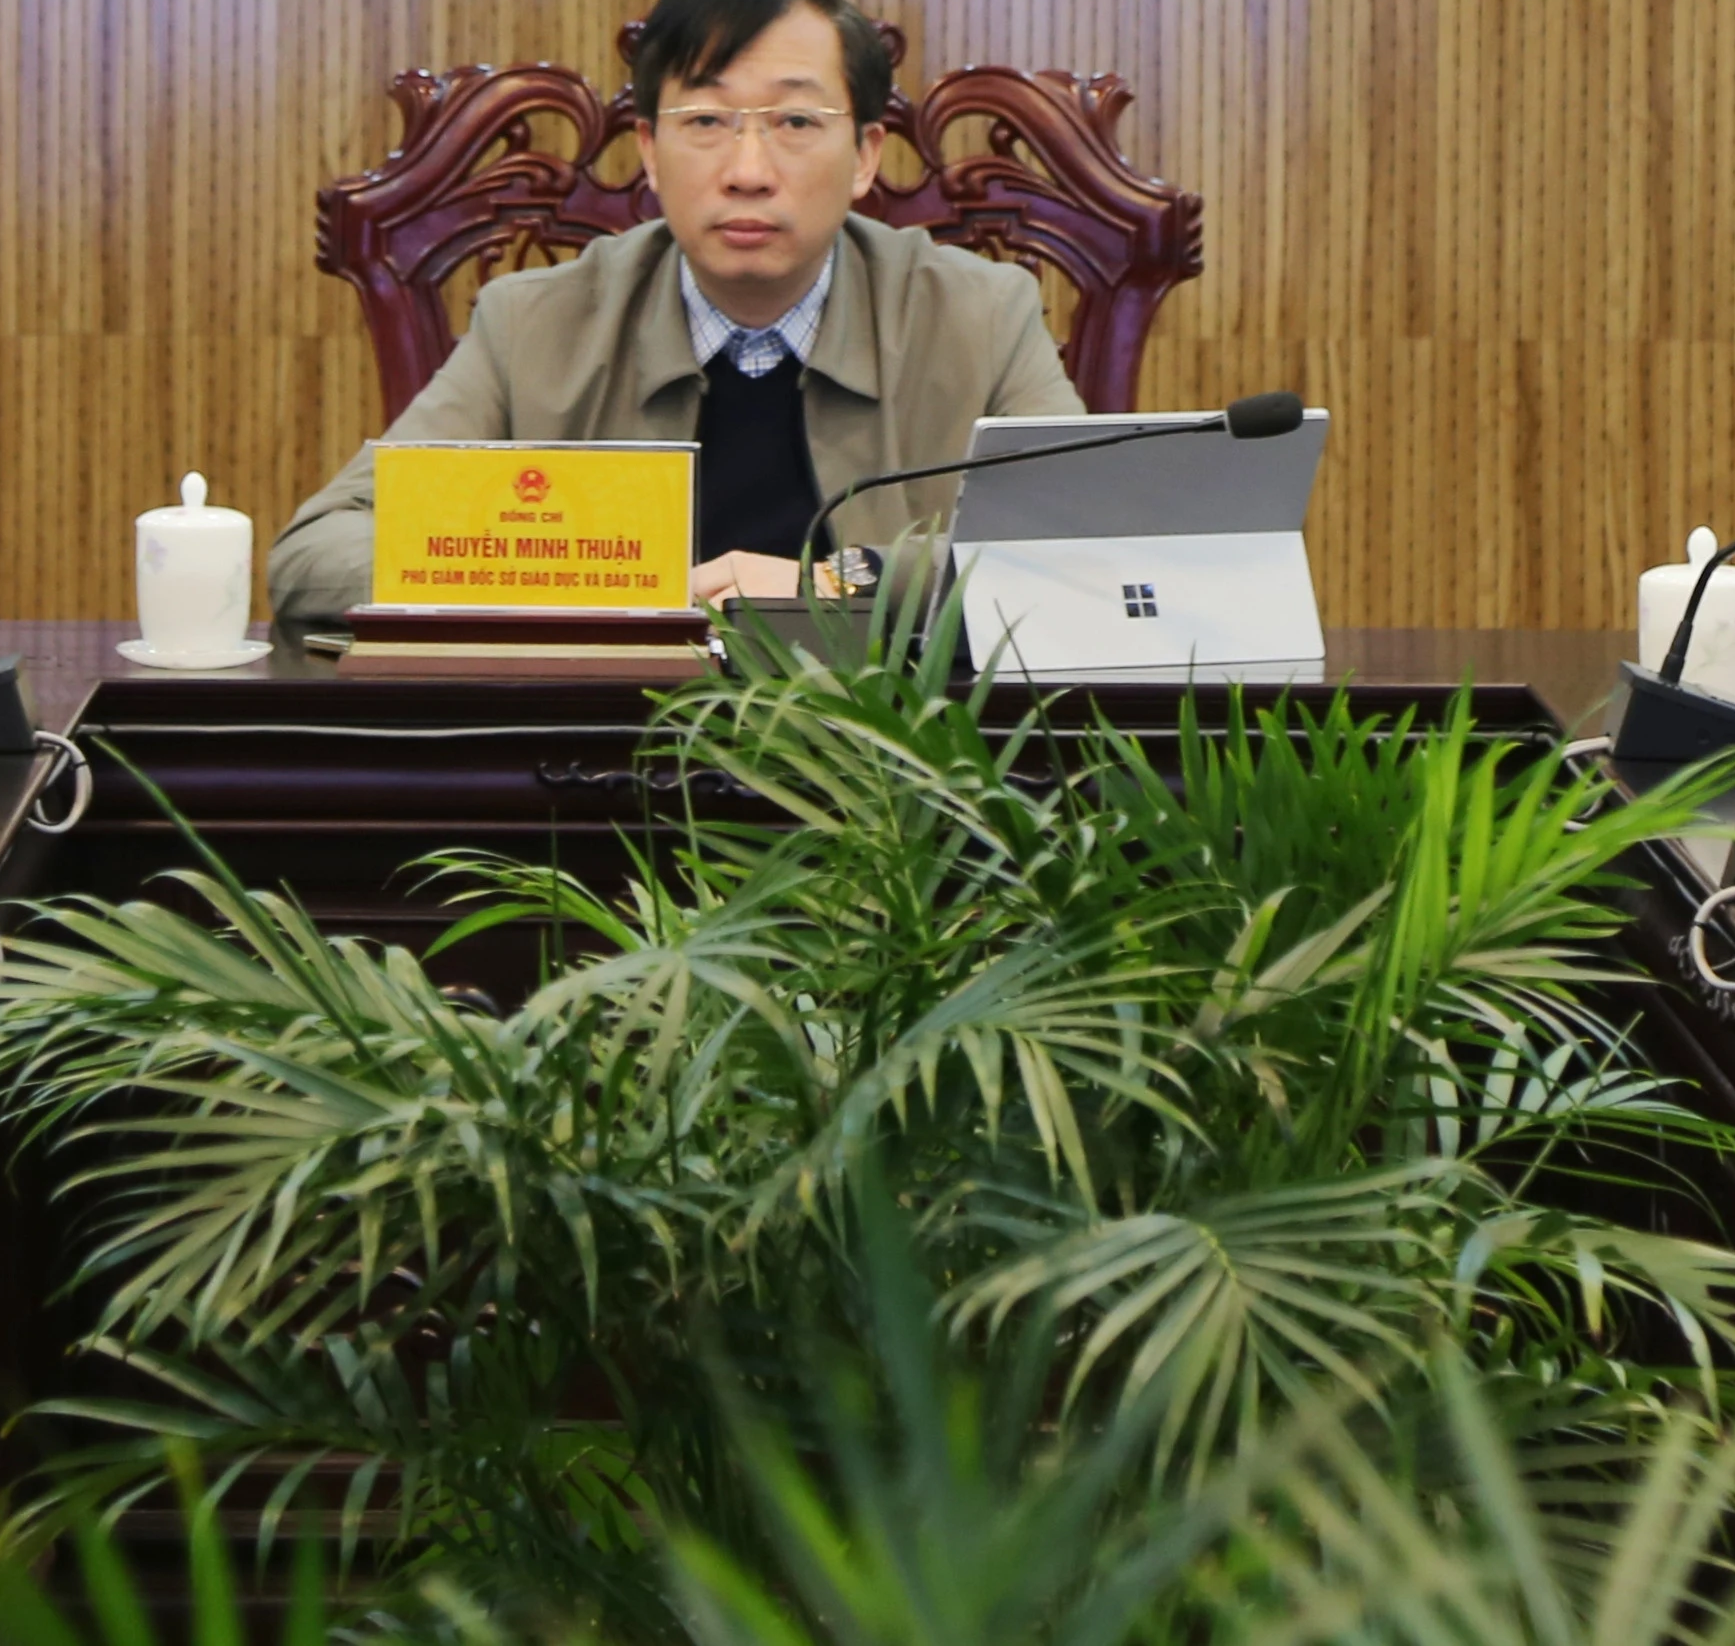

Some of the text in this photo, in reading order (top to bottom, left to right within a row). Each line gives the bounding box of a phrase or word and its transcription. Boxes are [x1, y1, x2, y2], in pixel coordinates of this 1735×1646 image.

[427, 529, 642, 566] NGUYỄN MINH THUẬN
